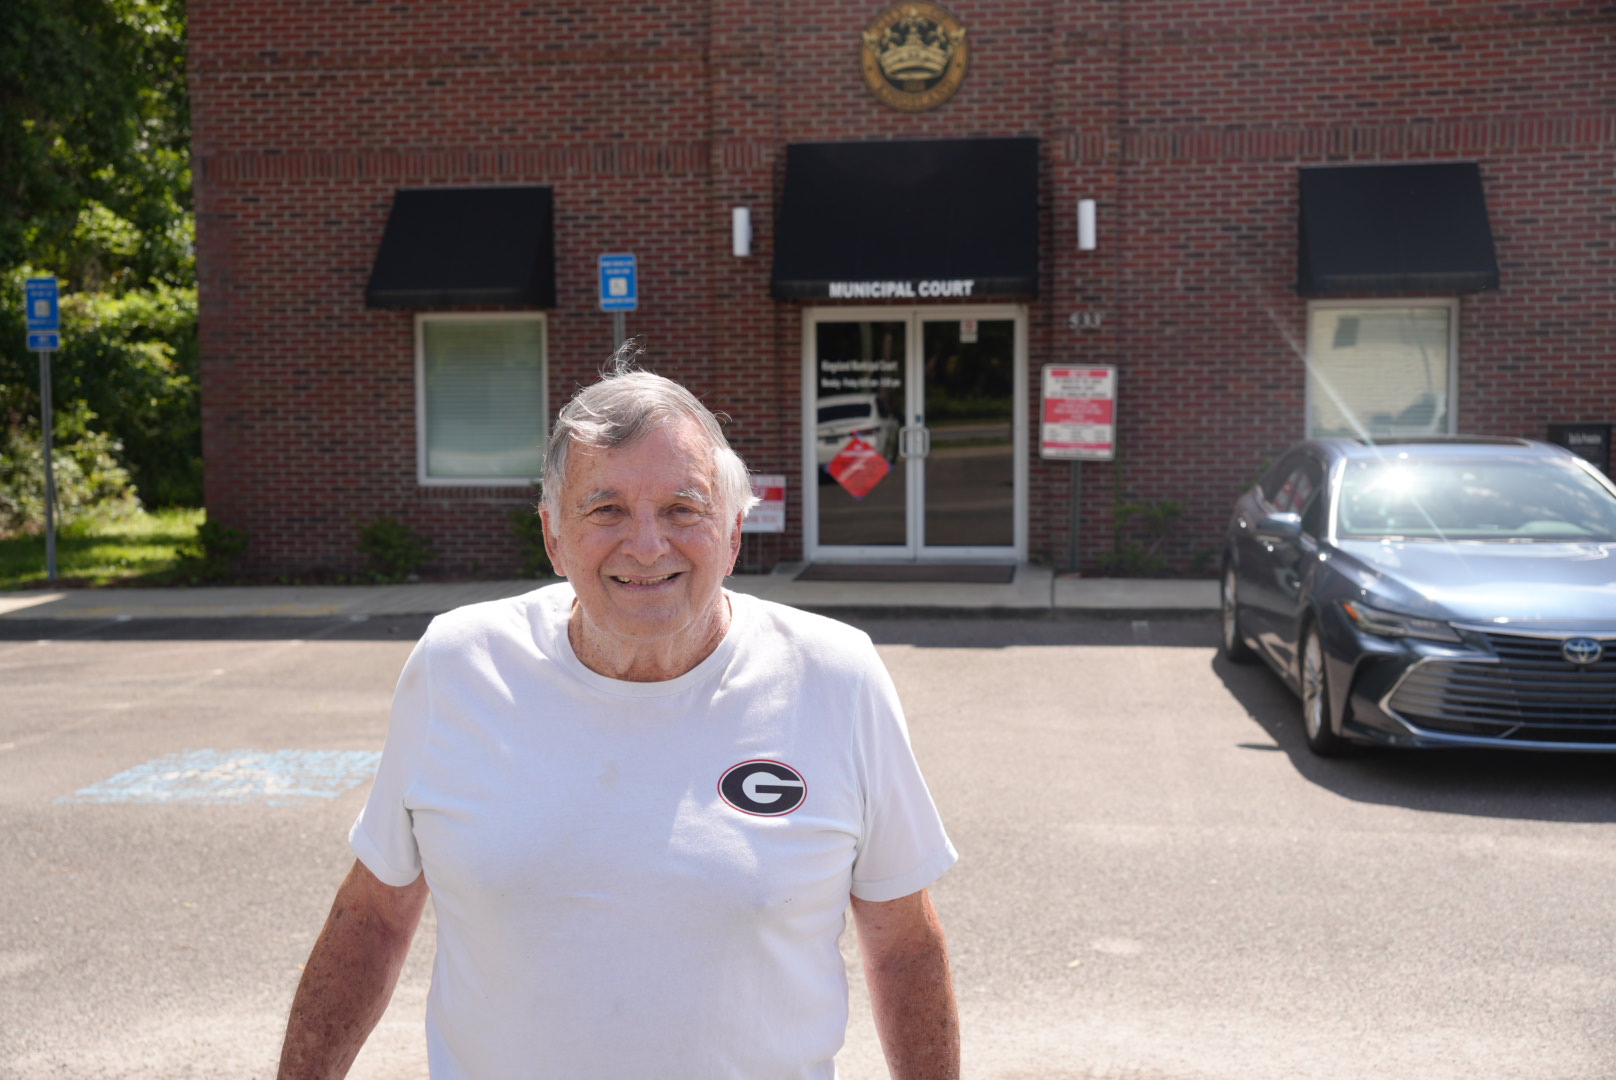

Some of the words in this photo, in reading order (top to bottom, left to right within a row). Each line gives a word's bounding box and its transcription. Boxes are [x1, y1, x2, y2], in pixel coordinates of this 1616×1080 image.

[829, 281, 916, 298] MUNICIPAL
[918, 279, 974, 297] COURT
[721, 762, 804, 814] G
